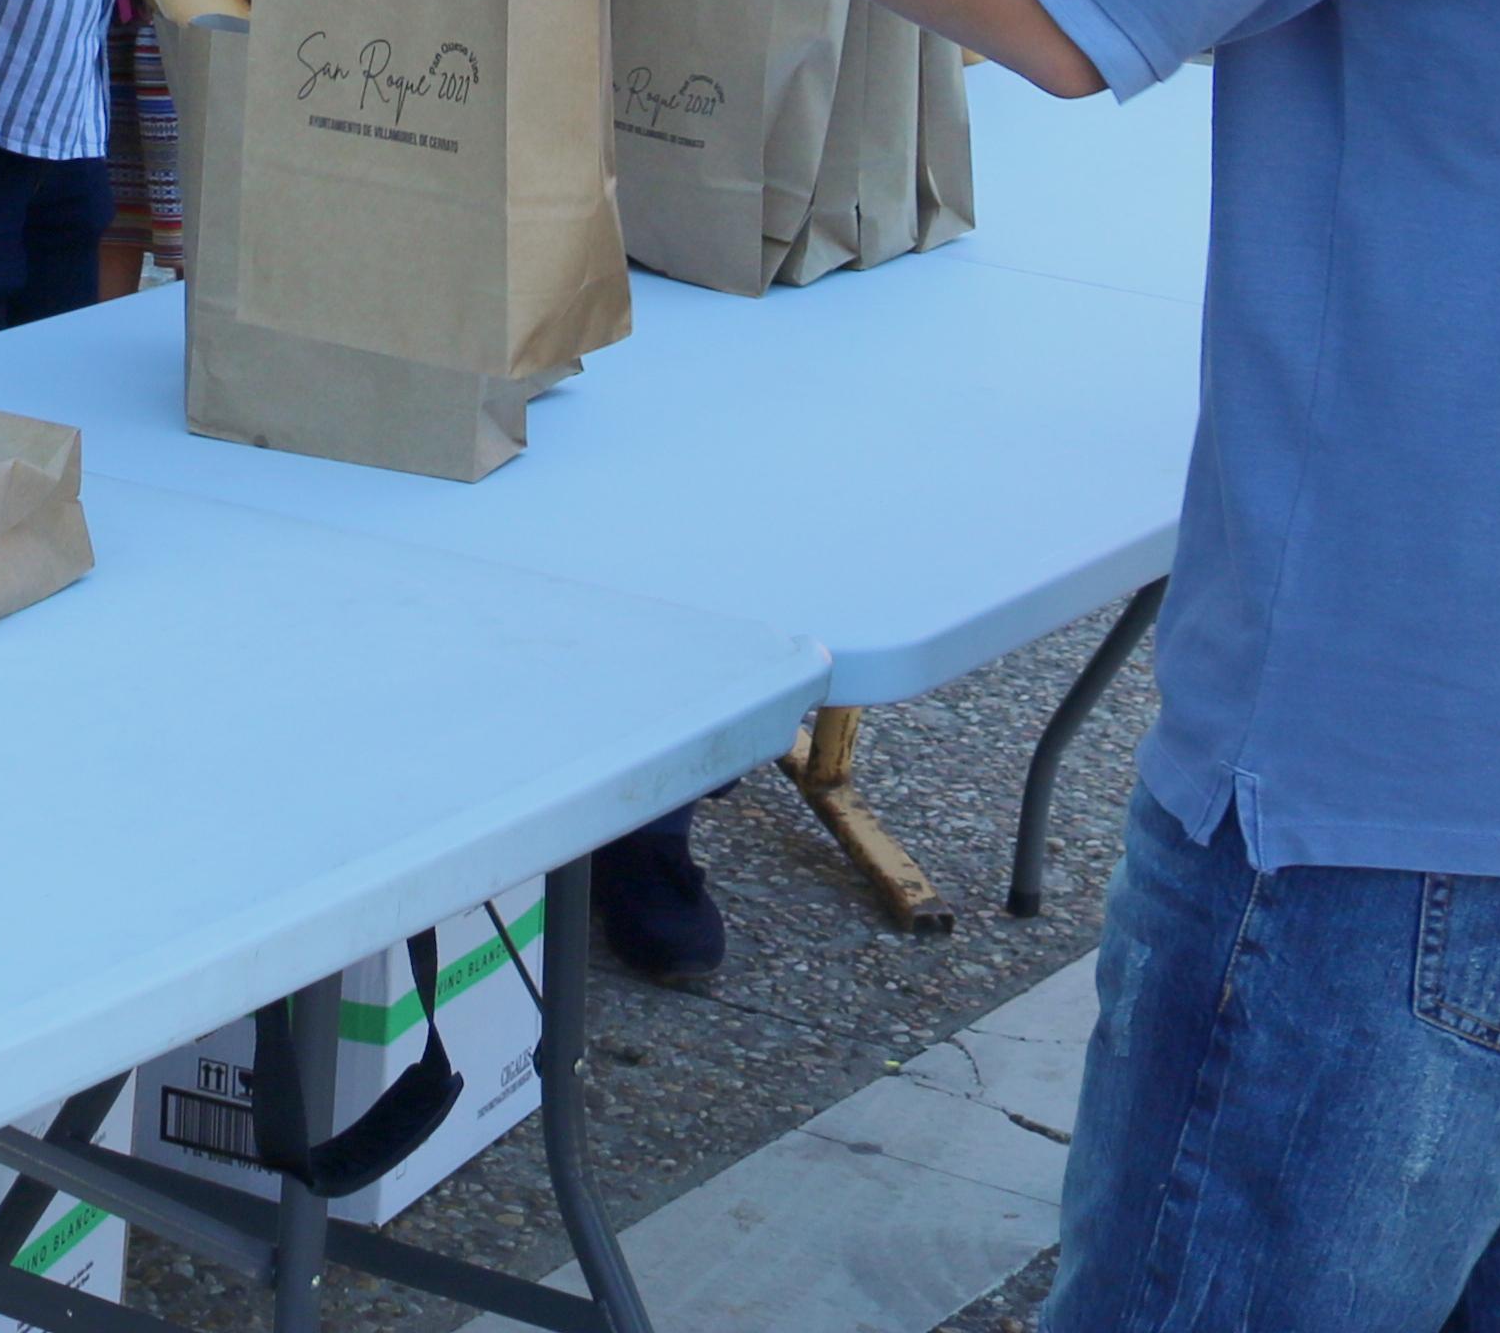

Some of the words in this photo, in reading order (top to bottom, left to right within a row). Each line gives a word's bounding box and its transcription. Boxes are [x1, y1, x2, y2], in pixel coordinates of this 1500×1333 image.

[297, 31, 350, 100] San
[359, 39, 431, 127] Roque
[438, 72, 471, 104] 2021
